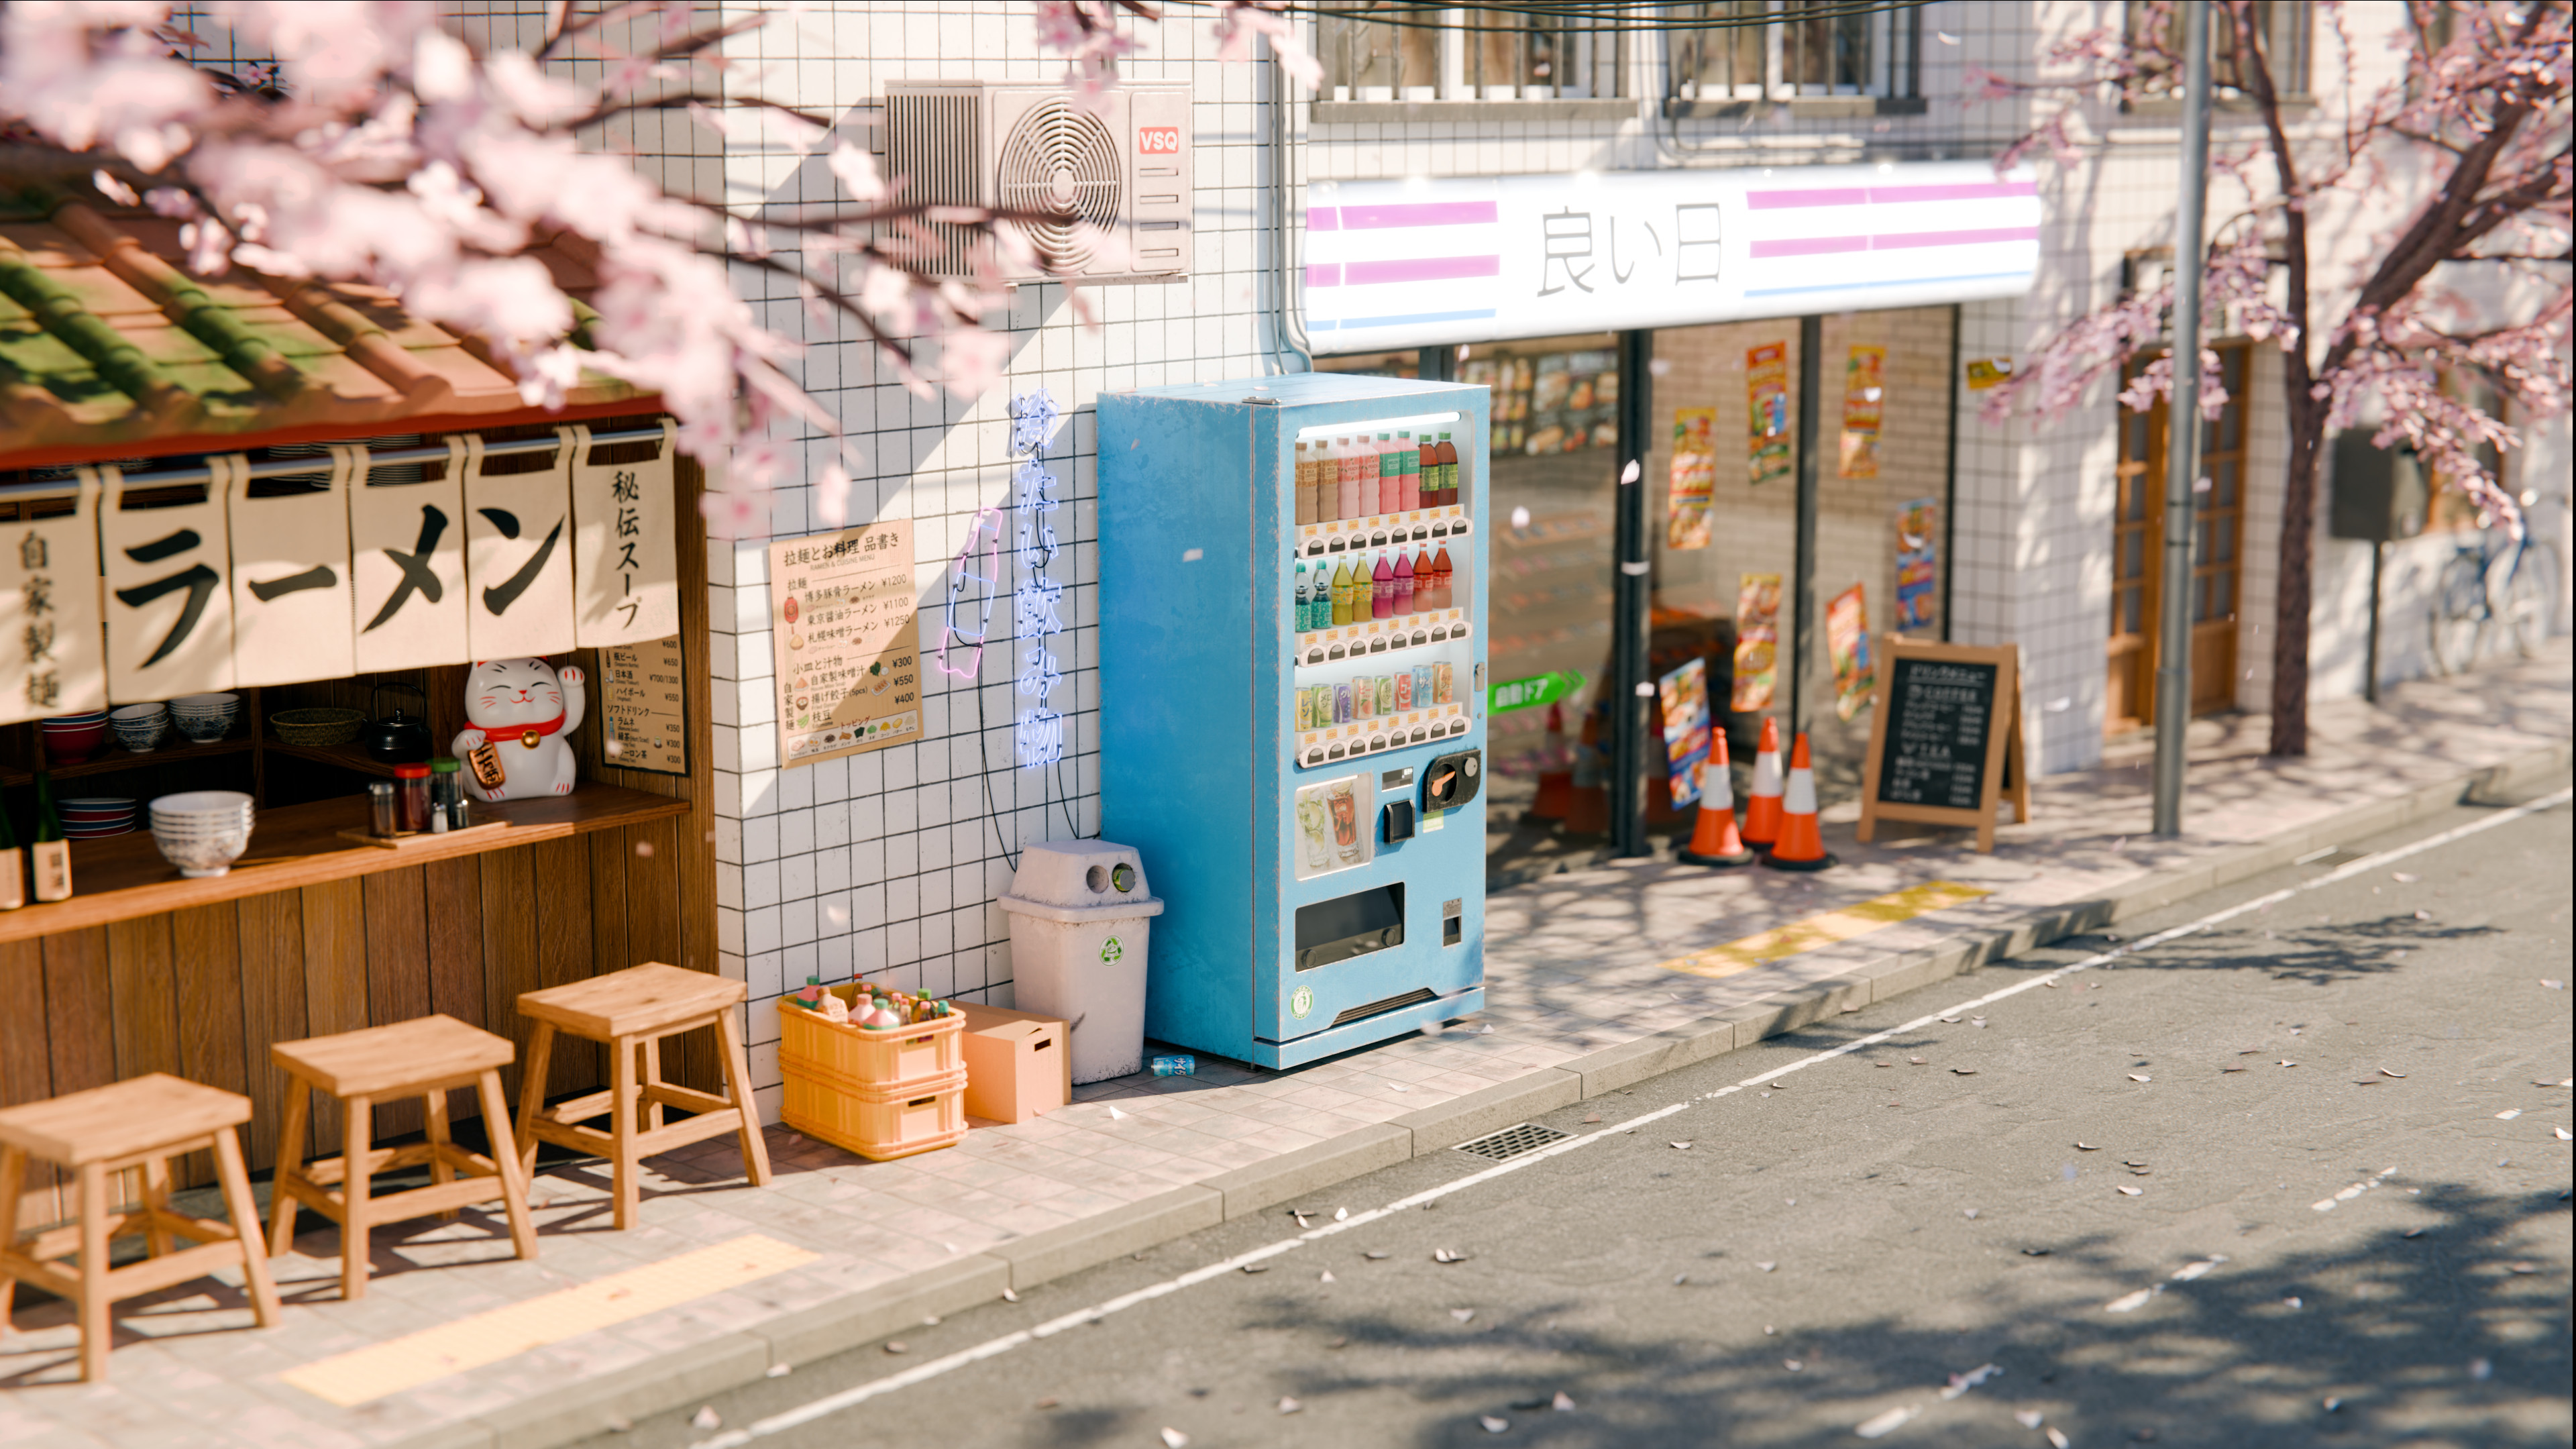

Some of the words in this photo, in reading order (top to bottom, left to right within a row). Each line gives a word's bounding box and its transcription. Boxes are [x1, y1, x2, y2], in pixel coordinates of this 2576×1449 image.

[1140, 131, 1179, 152] VSQ
[1537, 203, 1721, 297] 良い日
[611, 470, 642, 629] 秘伝スープ
[784, 539, 859, 567] 拉麺とお料理
[864, 532, 899, 552] 品書き
[810, 562, 830, 571] RAMEN
[837, 557, 858, 566] CUISINE
[859, 554, 875, 562] MENU
[115, 503, 566, 670] ラーメン
[787, 577, 808, 592] 拉麺
[804, 580, 875, 603] 博多豚骨ラーメン
[881, 574, 907, 588] ¥1200
[1014, 388, 1063, 769] 冷たい飲み物
[18, 529, 60, 708] 自家製麺
[807, 604, 877, 627] 東京醤油ラーメン
[883, 597, 909, 610] ¥1100
[808, 621, 879, 644] 札幌味噌ラーメン
[884, 614, 910, 628] ¥1250
[662, 640, 678, 649] ¥600
[663, 657, 678, 667] ¥650
[793, 655, 843, 675] 小皿と汁物
[810, 665, 866, 686] 自家製味噌汁
[892, 655, 912, 669] ¥300
[615, 669, 633, 680] 日本酒
[649, 674, 679, 684] ¥700/1300
[894, 674, 914, 687] ¥550
[616, 687, 645, 698] ハイボール
[665, 692, 679, 702] ¥550
[1924, 685, 1977, 703] COFFEE
[607, 704, 649, 717] ソフトドリンク
[784, 683, 796, 731] 自家製麺
[812, 709, 832, 723] 枝豆
[894, 692, 915, 704] ¥400
[617, 716, 635, 727] ラムネ
[665, 723, 680, 733] ¥350
[841, 715, 871, 730] トッピング
[666, 739, 680, 749] ¥300
[667, 755, 681, 765] ¥300
